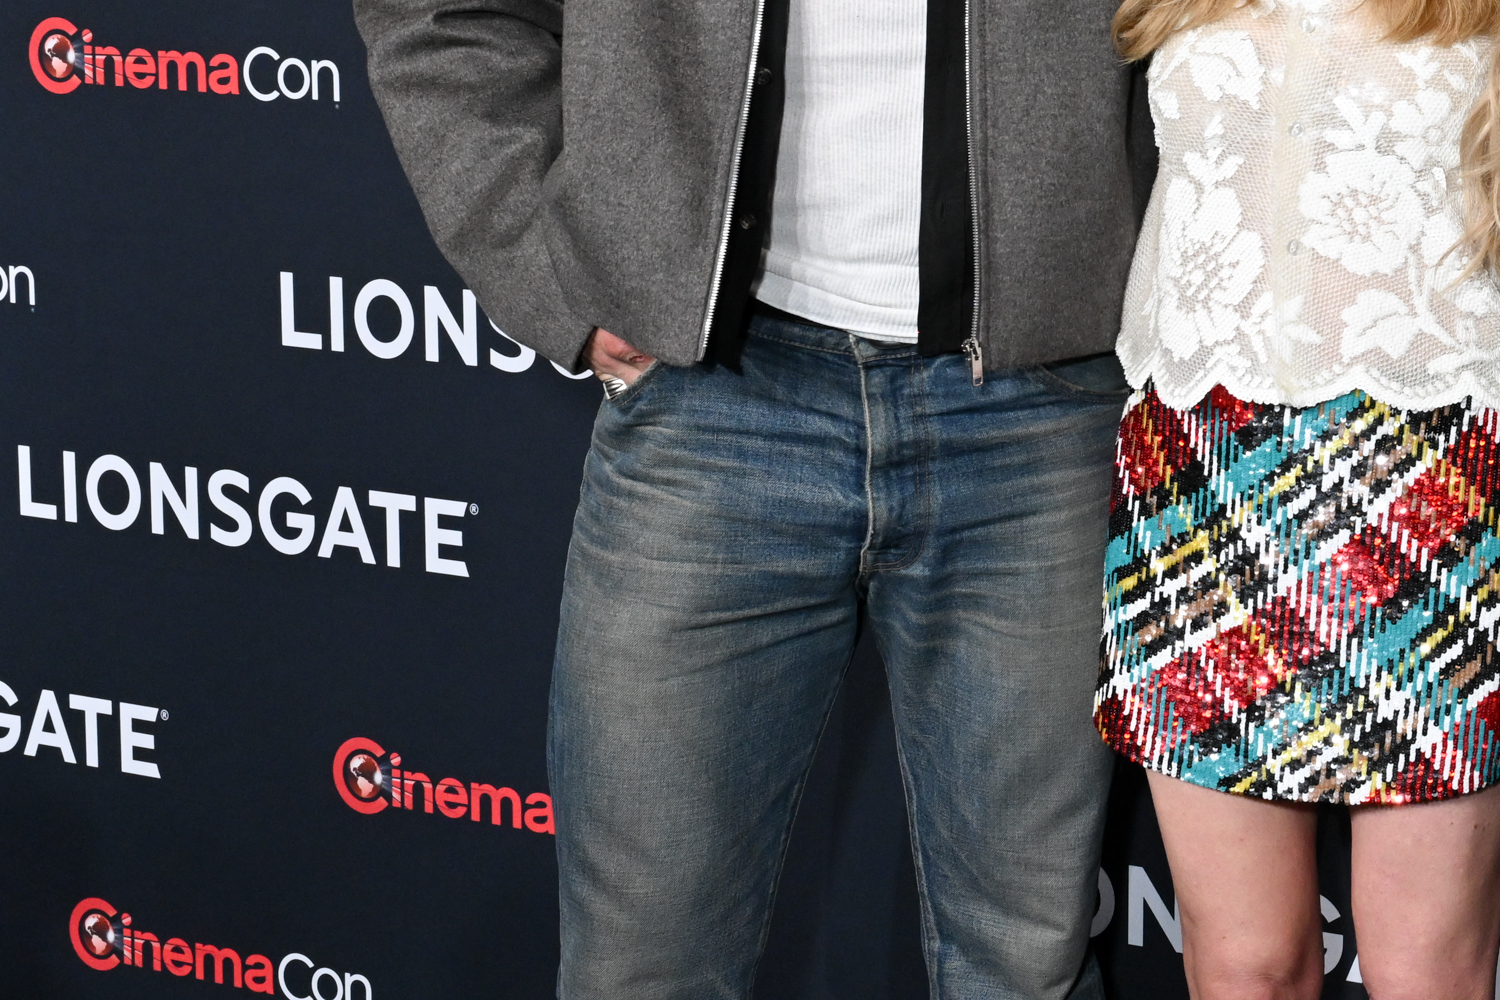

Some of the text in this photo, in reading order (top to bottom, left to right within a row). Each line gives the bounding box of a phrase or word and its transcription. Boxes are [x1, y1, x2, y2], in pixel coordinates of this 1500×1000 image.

[29, 17, 340, 102] CinemaCon
[17, 445, 470, 577] LIONSGATE
[69, 897, 372, 1000] CinemaCon
